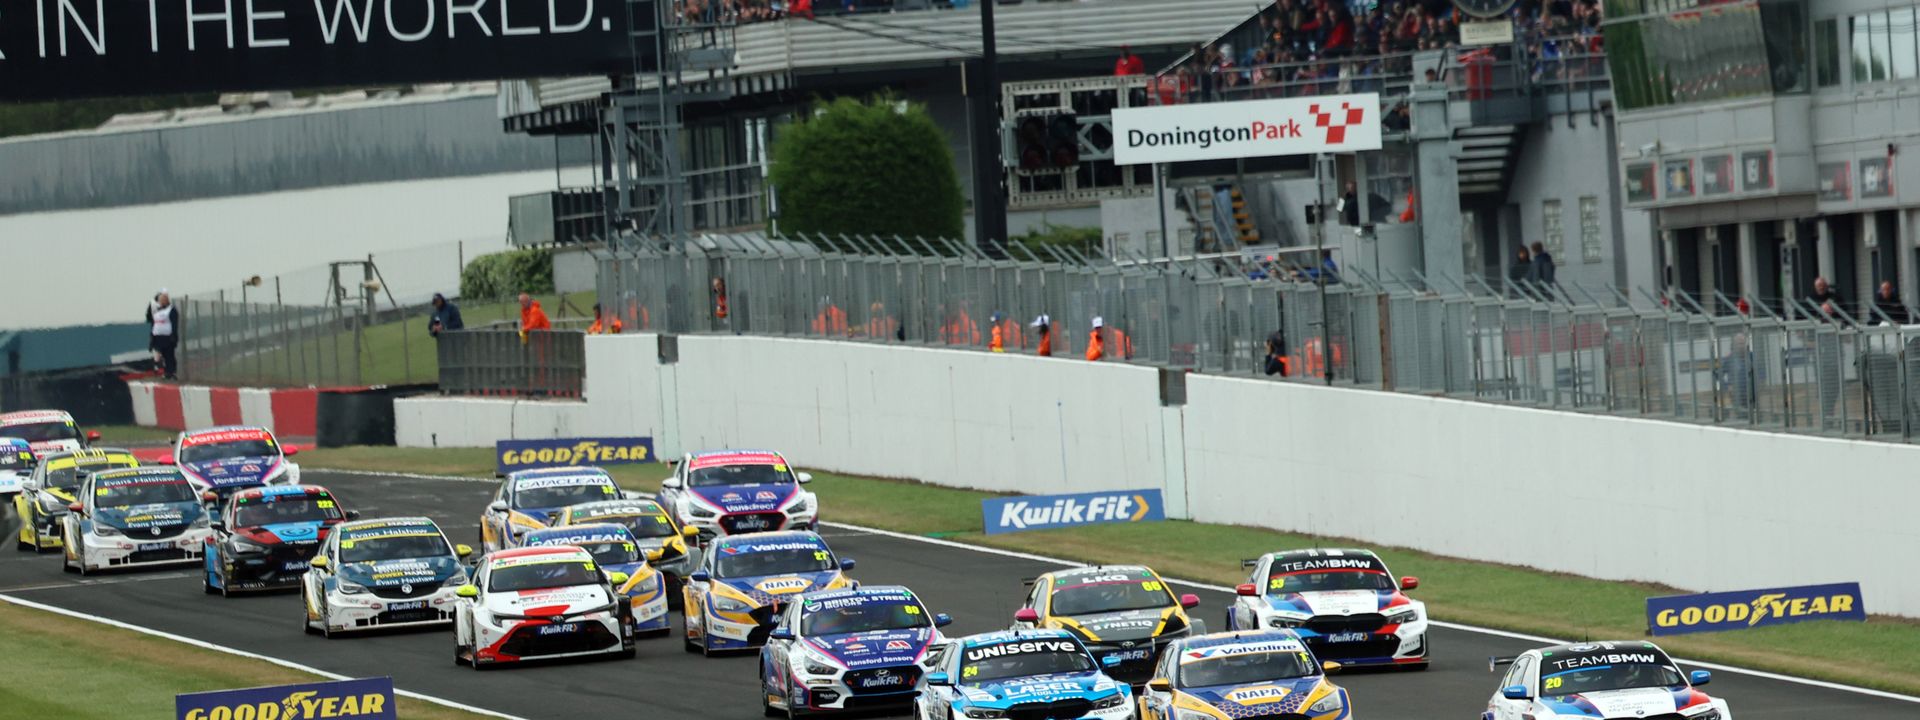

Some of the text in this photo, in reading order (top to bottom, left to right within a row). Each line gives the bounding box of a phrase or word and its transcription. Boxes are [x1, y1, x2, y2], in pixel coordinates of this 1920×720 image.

[37, 0, 105, 57] IN
[187, 431, 263, 444] Vansdirect
[502, 442, 647, 465] GOODYEAR
[104, 476, 175, 487] Evans Halshaw
[519, 477, 608, 489] CATACLEAN
[317, 500, 334, 508] 222
[590, 506, 642, 517] LKQ
[350, 528, 428, 540] Evans Halshaw
[531, 534, 627, 547] CATACLEAN
[752, 543, 819, 552] Valvoline
[813, 551, 828, 561] 27
[401, 576, 435, 585] Halshaw
[764, 580, 804, 589] NAPA
[1082, 574, 1130, 584] LKQ
[1270, 578, 1285, 590] 33
[824, 597, 869, 606] BRISTOL
[1656, 593, 1854, 627] GOODYEAR
[1221, 643, 1297, 655] Valvoline
[847, 655, 914, 667] Hansford Sensors
[963, 666, 978, 677] 24
[1004, 681, 1083, 696] LASER
[1545, 677, 1562, 689] 20
[1235, 688, 1283, 699] NAPA
[185, 691, 385, 720] GOODYEAR
